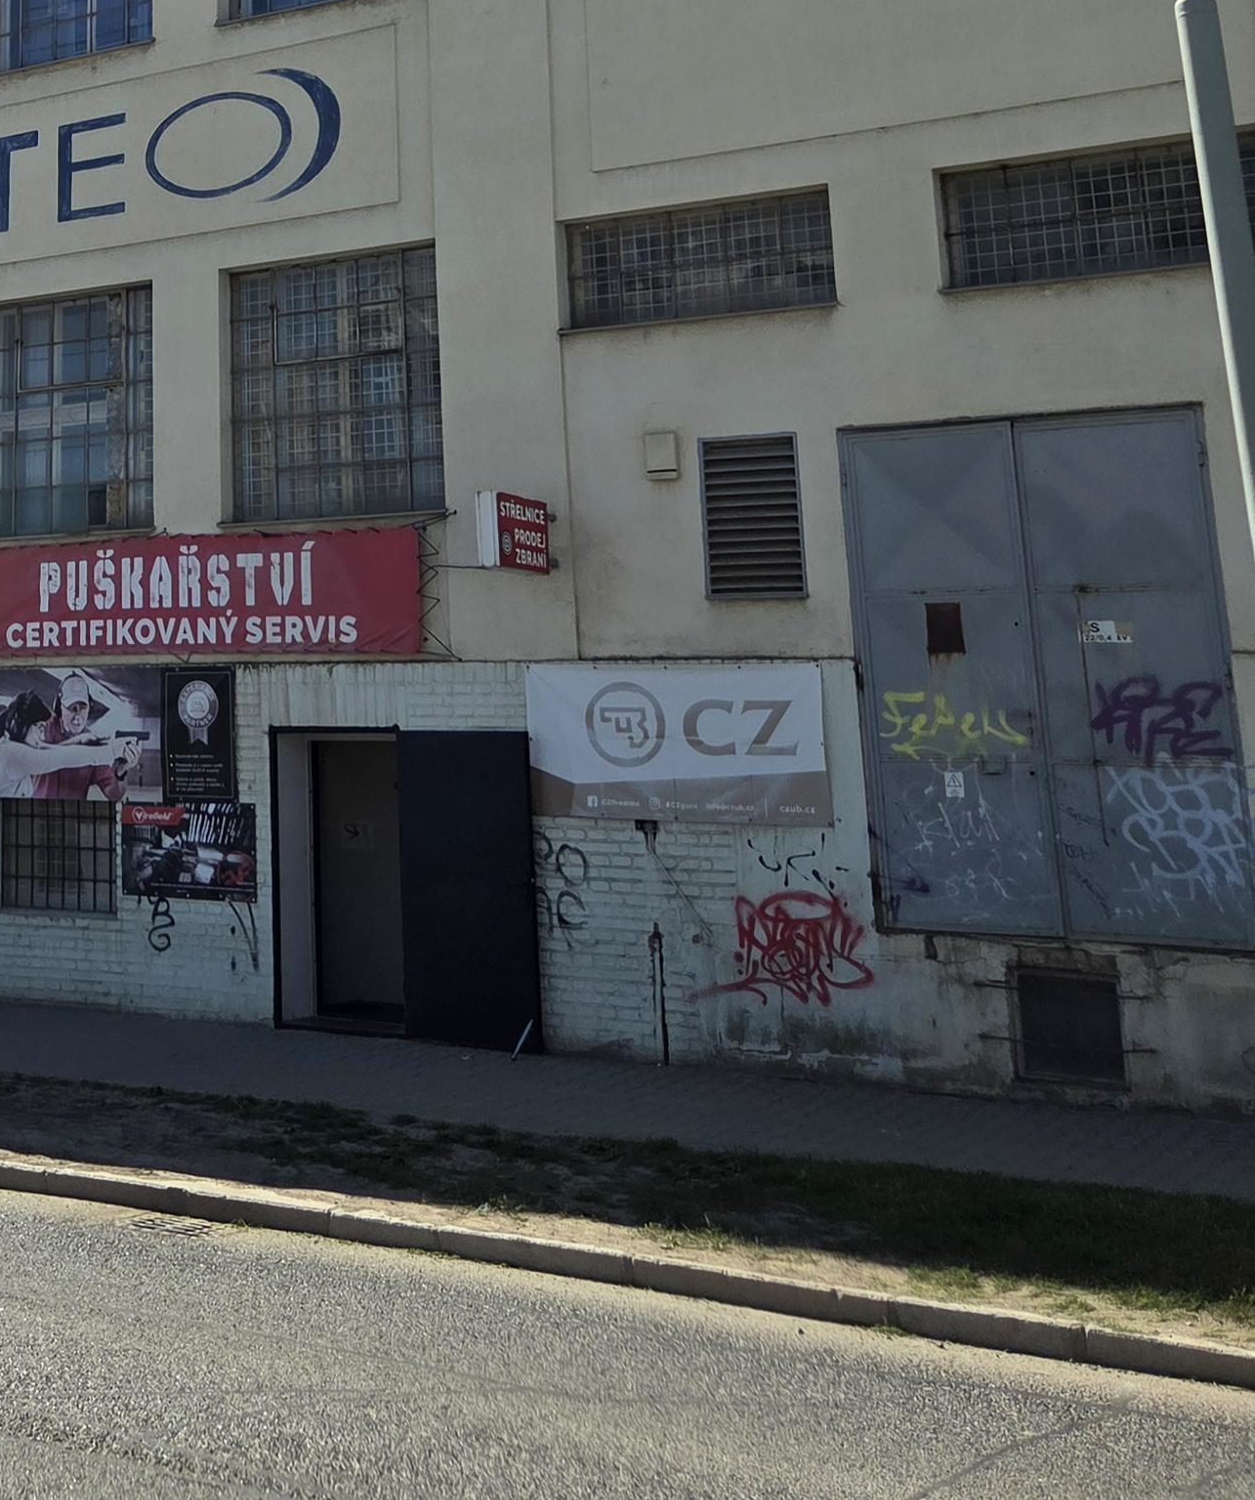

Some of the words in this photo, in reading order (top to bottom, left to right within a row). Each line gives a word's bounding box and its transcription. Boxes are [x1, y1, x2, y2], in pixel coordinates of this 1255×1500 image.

[499, 499, 546, 525] STŘELNICE
[514, 528, 546, 548] PRODEJ
[38, 540, 316, 613] PUŠKAŘSTVÍ
[5, 608, 238, 649] CERTIFIKOVANÝ
[244, 615, 359, 645] SERVIS
[682, 698, 800, 757] CZ
